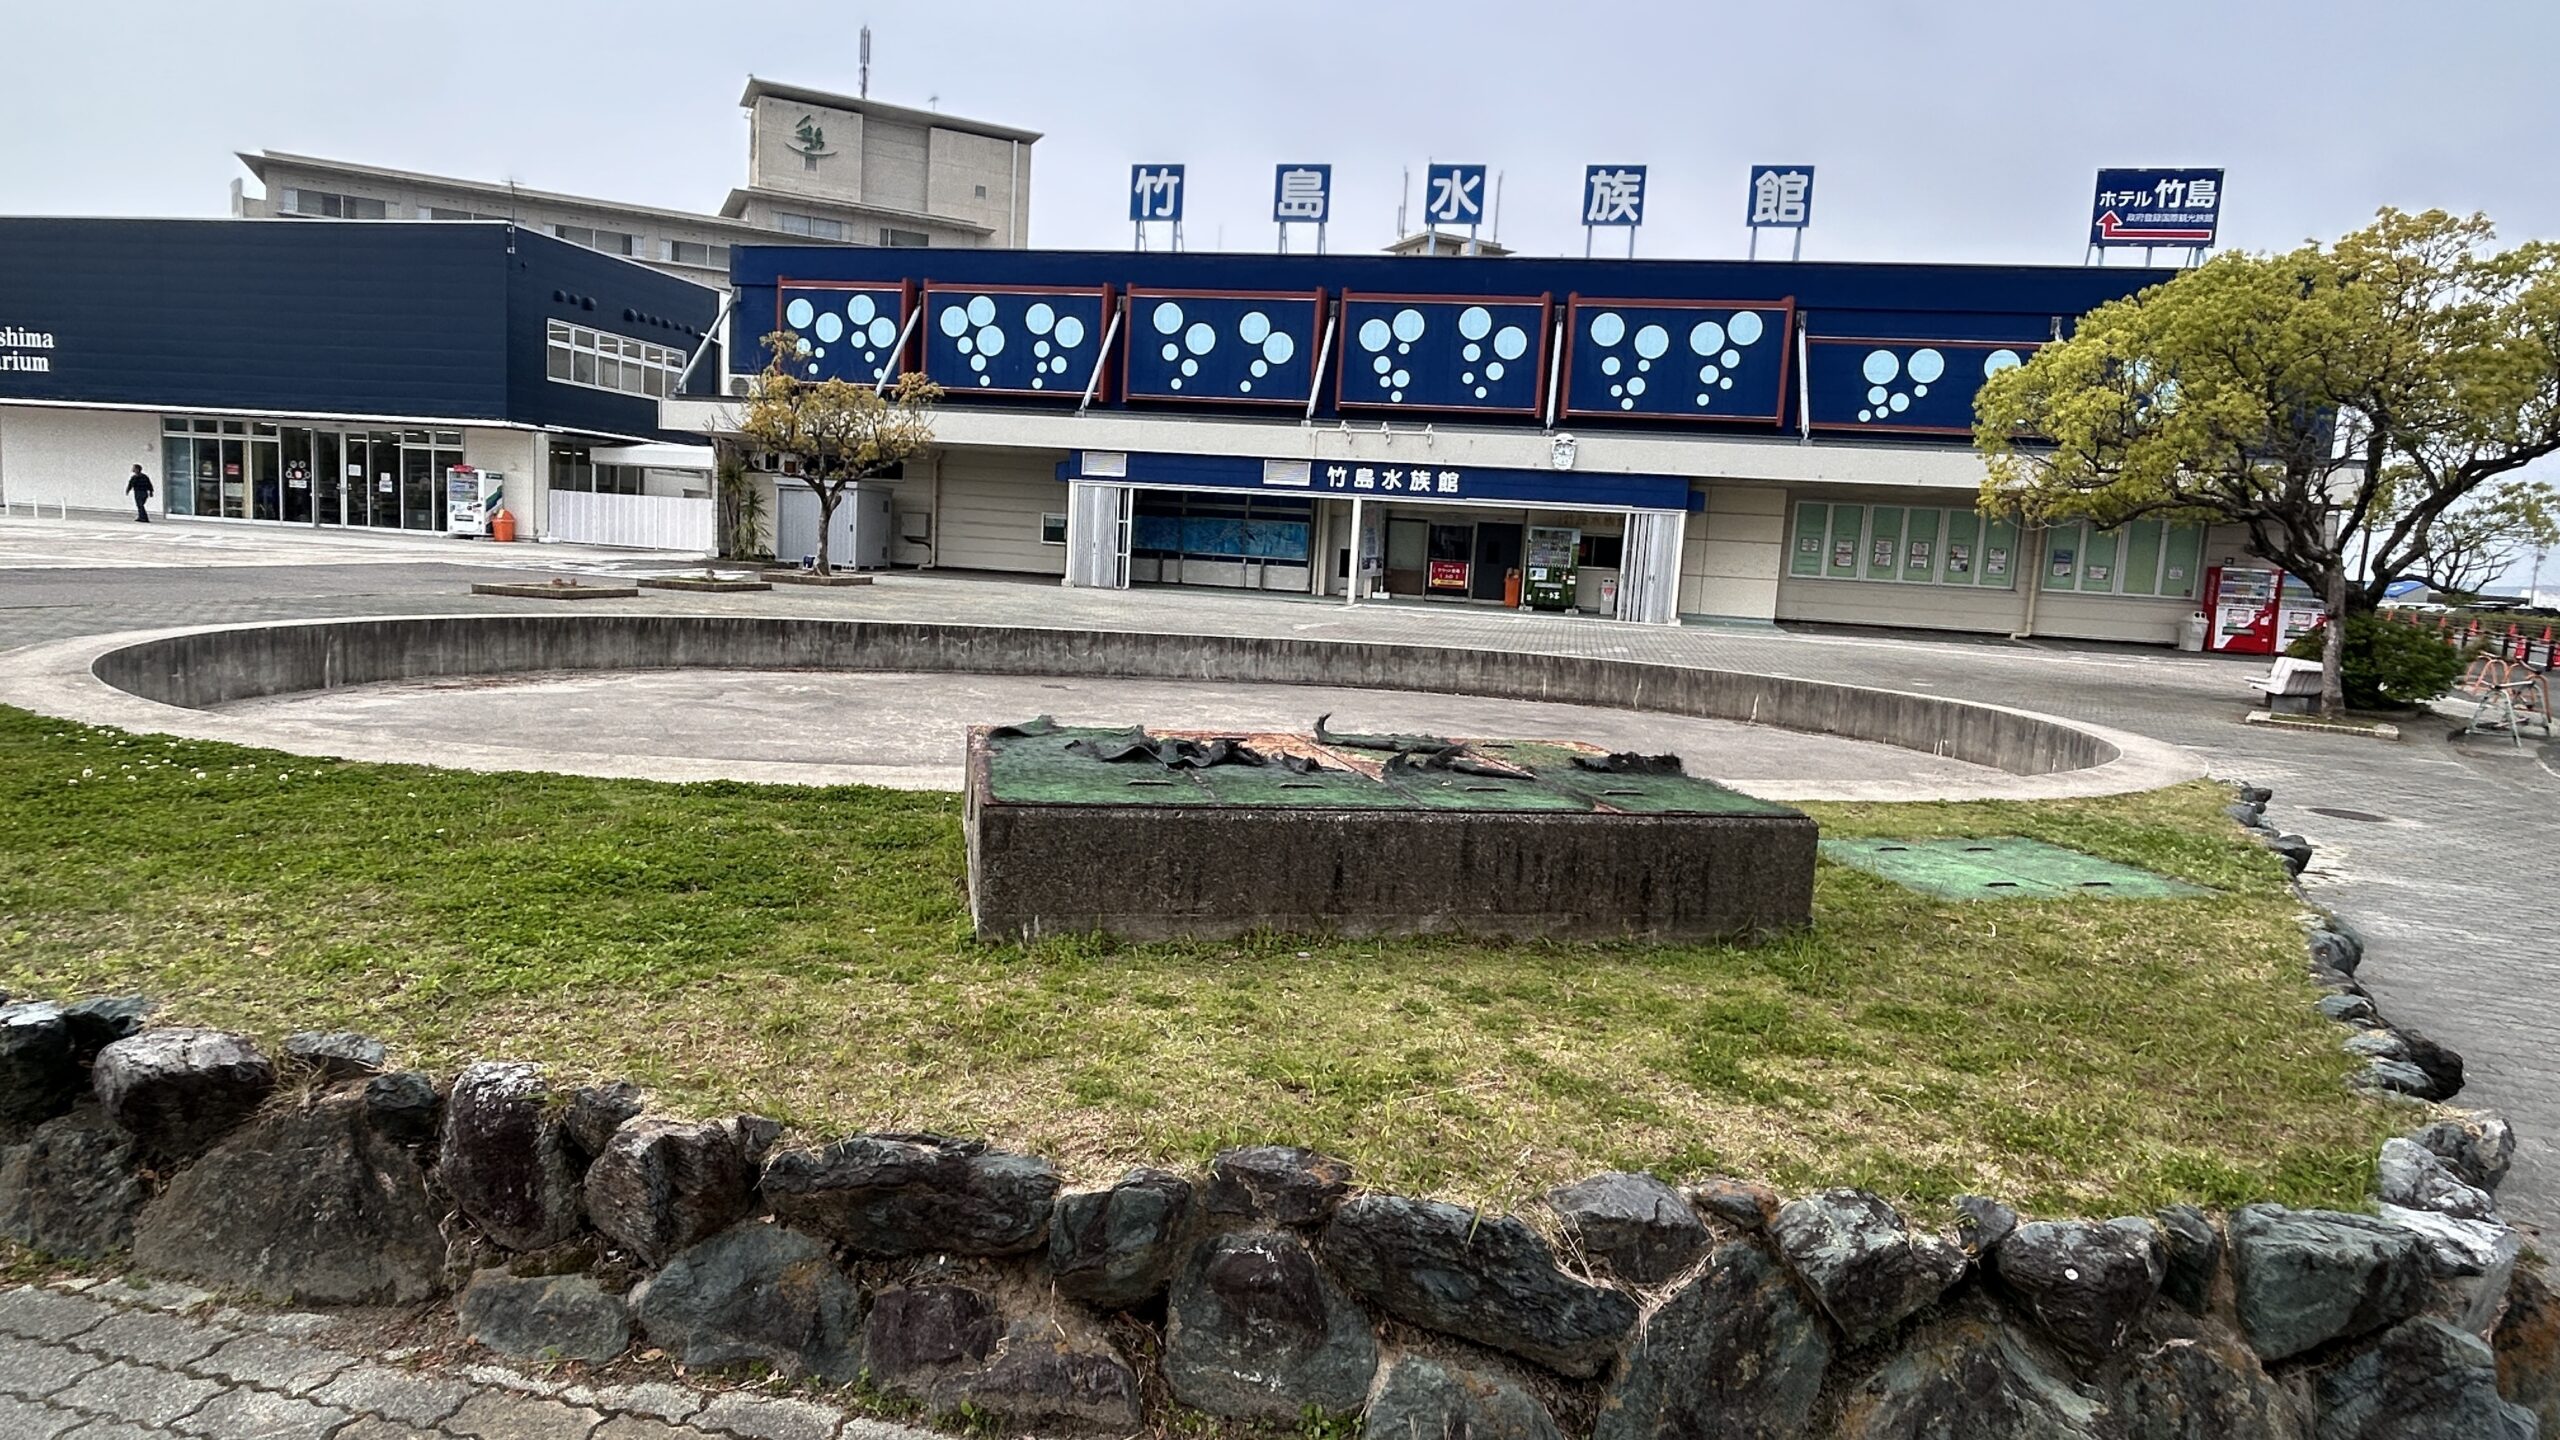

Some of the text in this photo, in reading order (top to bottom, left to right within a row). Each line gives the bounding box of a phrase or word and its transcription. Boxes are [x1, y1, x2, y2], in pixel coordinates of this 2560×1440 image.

[1135, 168, 1808, 223] 竹島水族館
[0, 350, 50, 372] rium
[1327, 466, 1459, 492] 竹島水族館
